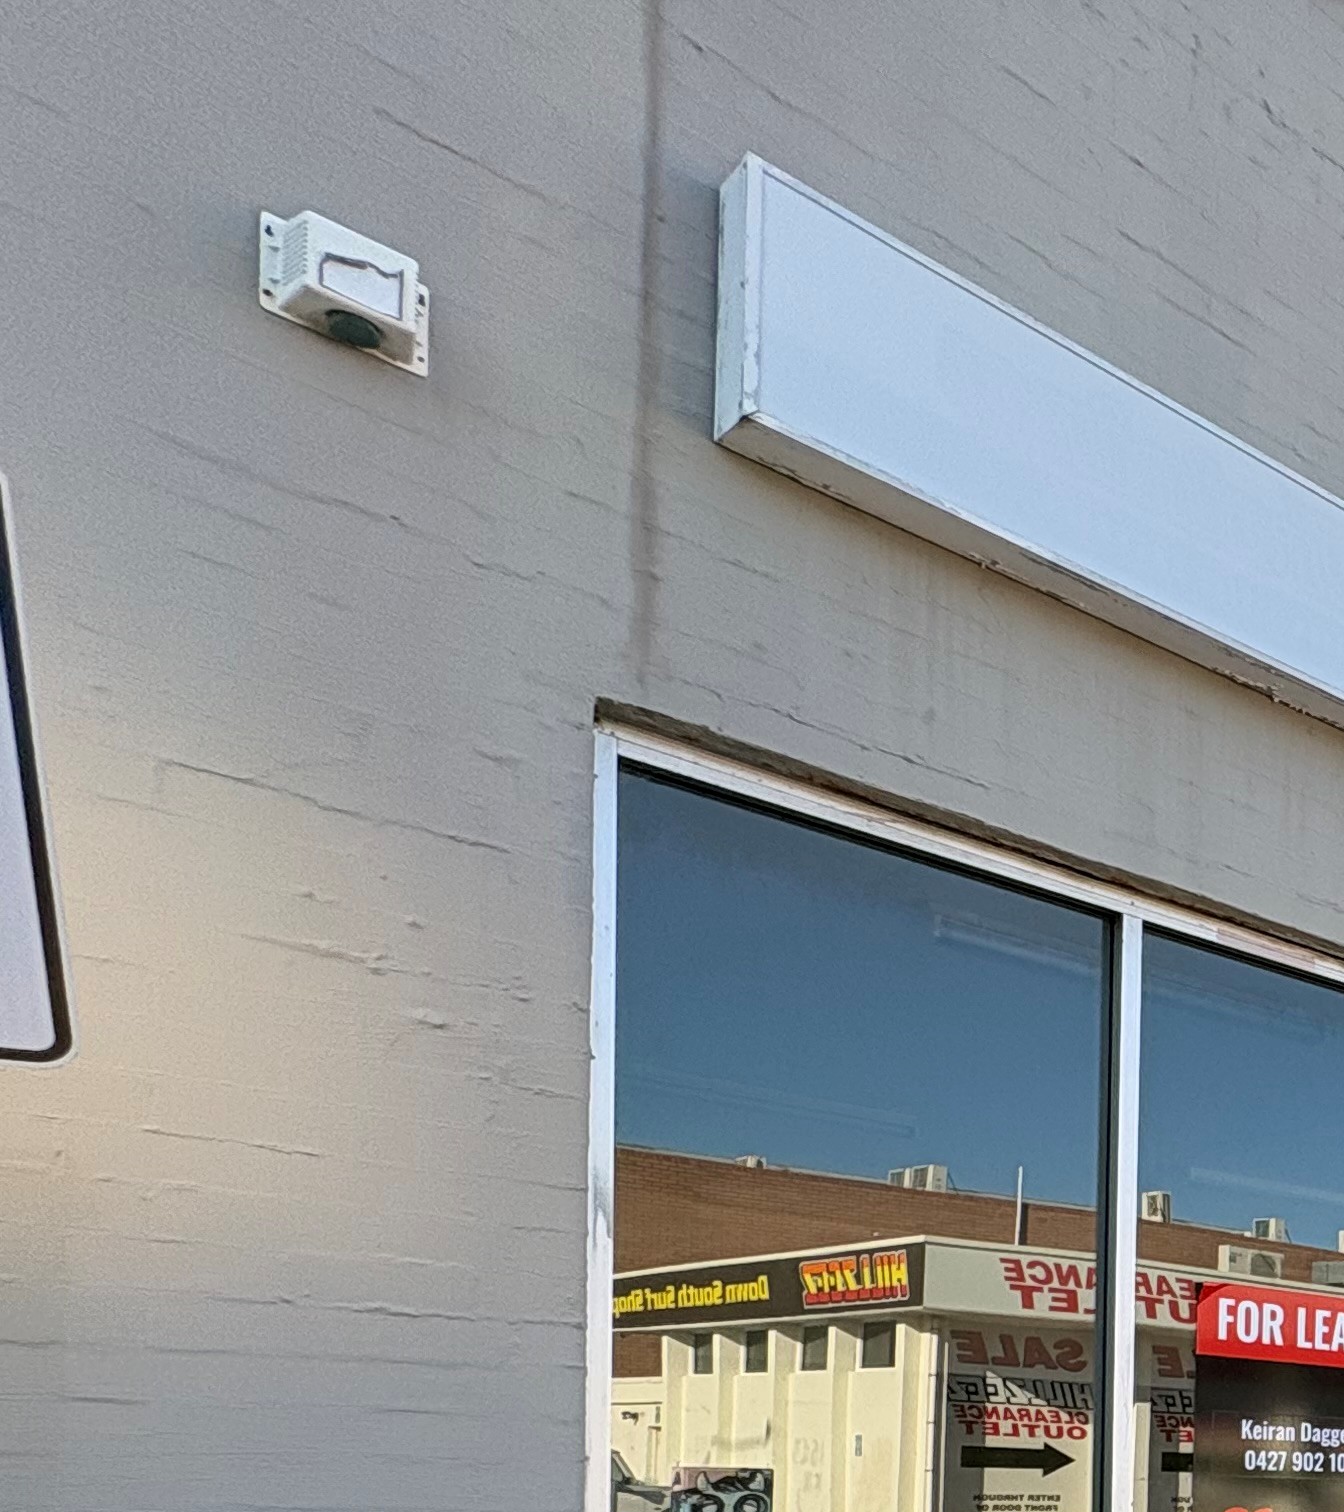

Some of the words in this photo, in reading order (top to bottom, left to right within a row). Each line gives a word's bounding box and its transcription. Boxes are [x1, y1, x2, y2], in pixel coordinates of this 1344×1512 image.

[1217, 1297, 1284, 1346] FOR
[1240, 1418, 1296, 1442] Keiran
[1244, 1449, 1288, 1472] 0427
[1292, 1451, 1325, 1473] 902
